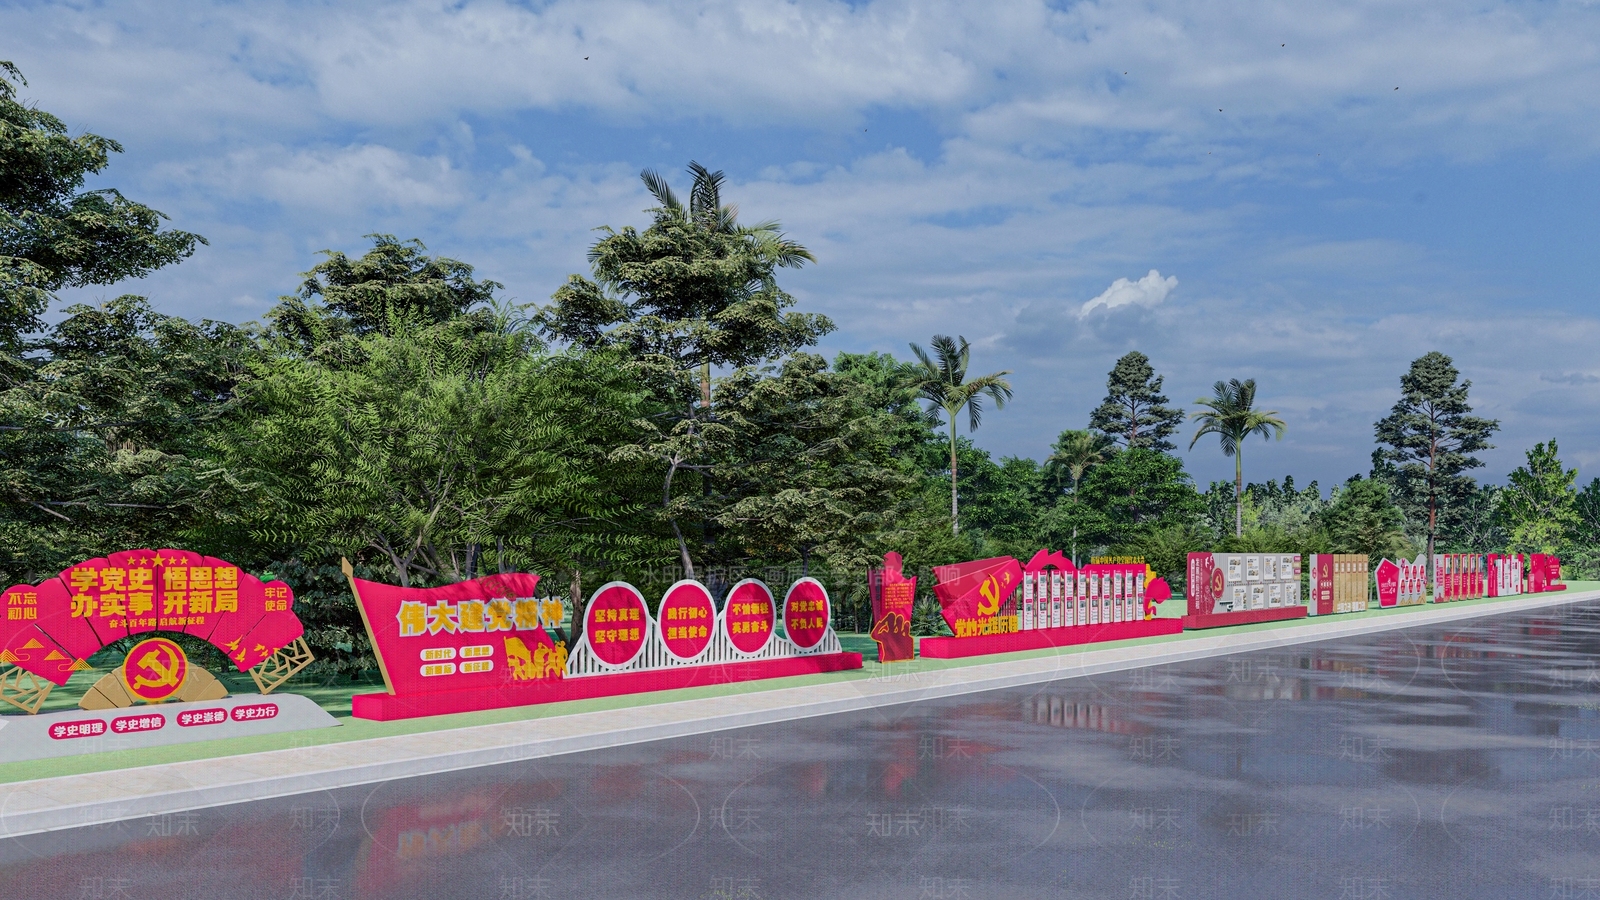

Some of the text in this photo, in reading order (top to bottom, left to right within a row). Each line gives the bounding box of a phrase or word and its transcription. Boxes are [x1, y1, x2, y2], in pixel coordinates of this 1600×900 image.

[71, 566, 238, 592] 学党史 悟思想
[8, 592, 37, 605] 不忘
[265, 587, 287, 599] 牢记
[70, 590, 238, 618] 办实事 开新局
[265, 600, 287, 612] 使命
[791, 600, 823, 613] 对党忠诚
[8, 607, 37, 620] 初心
[396, 597, 564, 637] 伟大建党精神
[595, 608, 640, 623] 坚持真理
[109, 616, 205, 628] 奋斗百年路 启航新征程
[732, 620, 768, 634] 英勇奋斗
[791, 617, 823, 630] 不负人民
[595, 628, 640, 643] 坚守理想
[668, 625, 707, 640] 担当使命
[425, 648, 452, 661] 新时代
[54, 706, 276, 737] 学史明理 学史增信 学史崇德 学史力行
